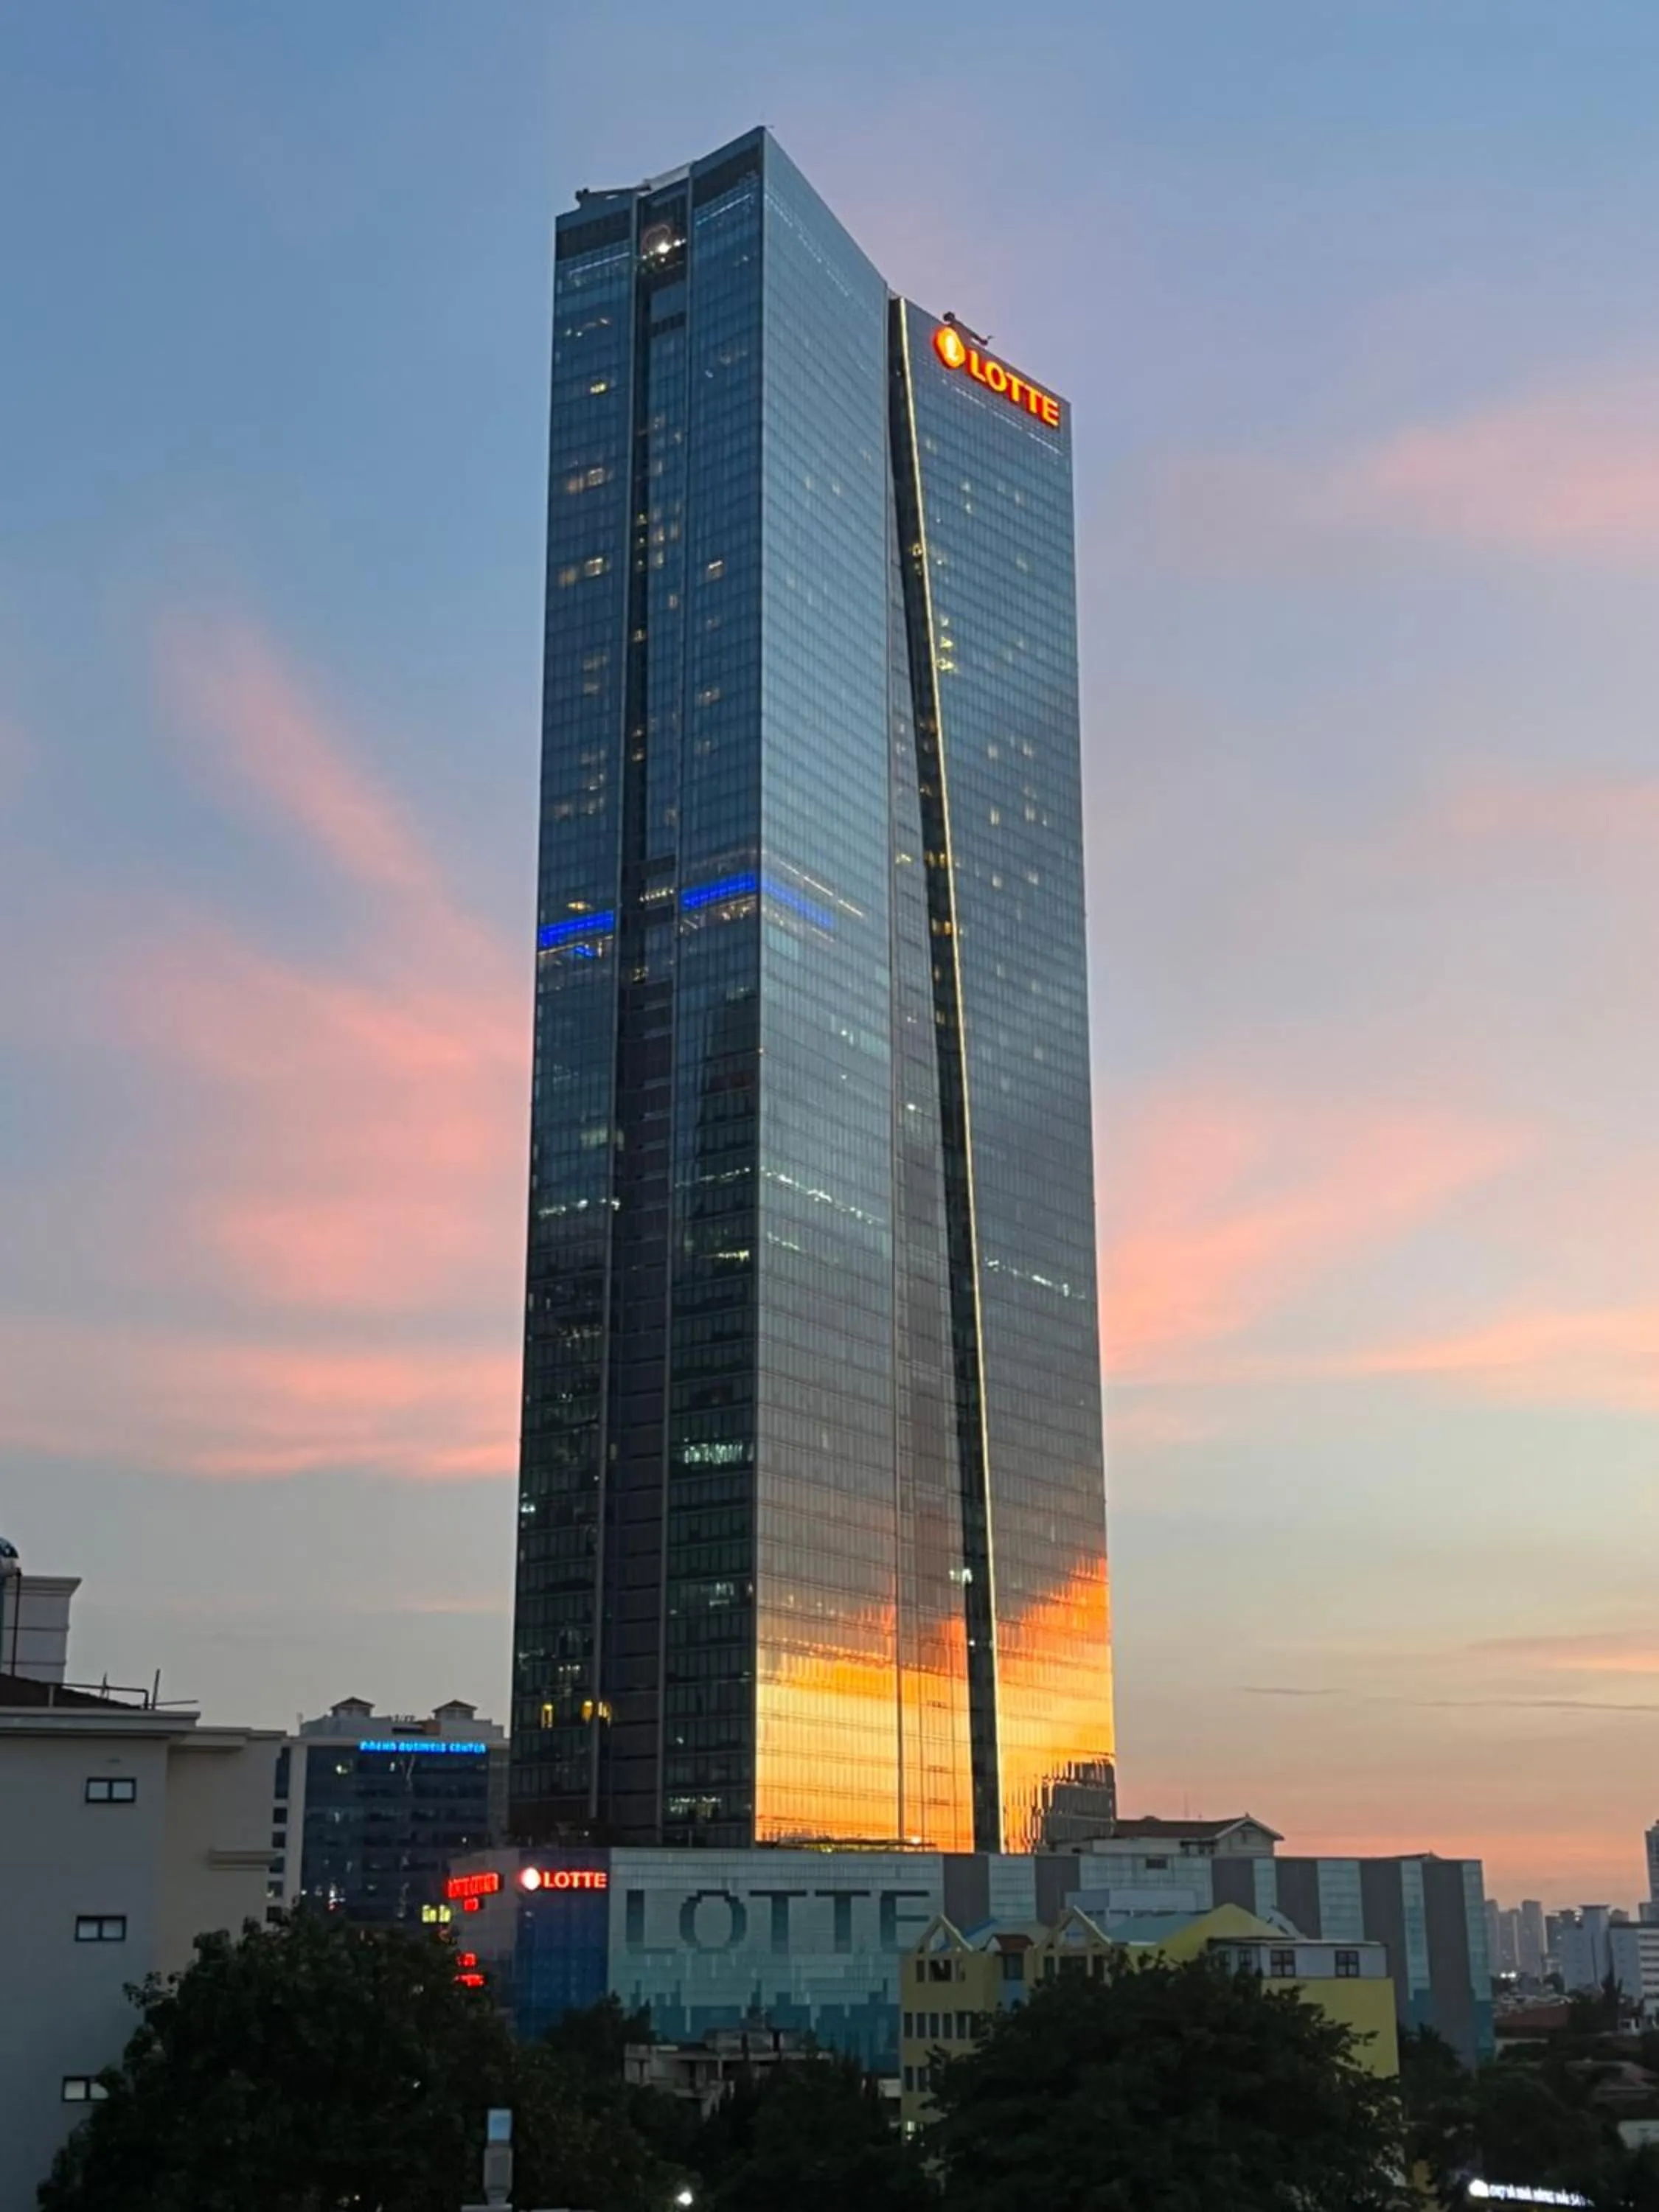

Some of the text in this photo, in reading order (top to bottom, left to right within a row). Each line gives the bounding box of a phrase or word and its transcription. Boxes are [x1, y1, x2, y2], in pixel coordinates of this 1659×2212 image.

[967, 348, 1060, 428] LOTTE
[543, 1871, 607, 1888] LOTTE
[625, 1889, 930, 1954] LOTTE
